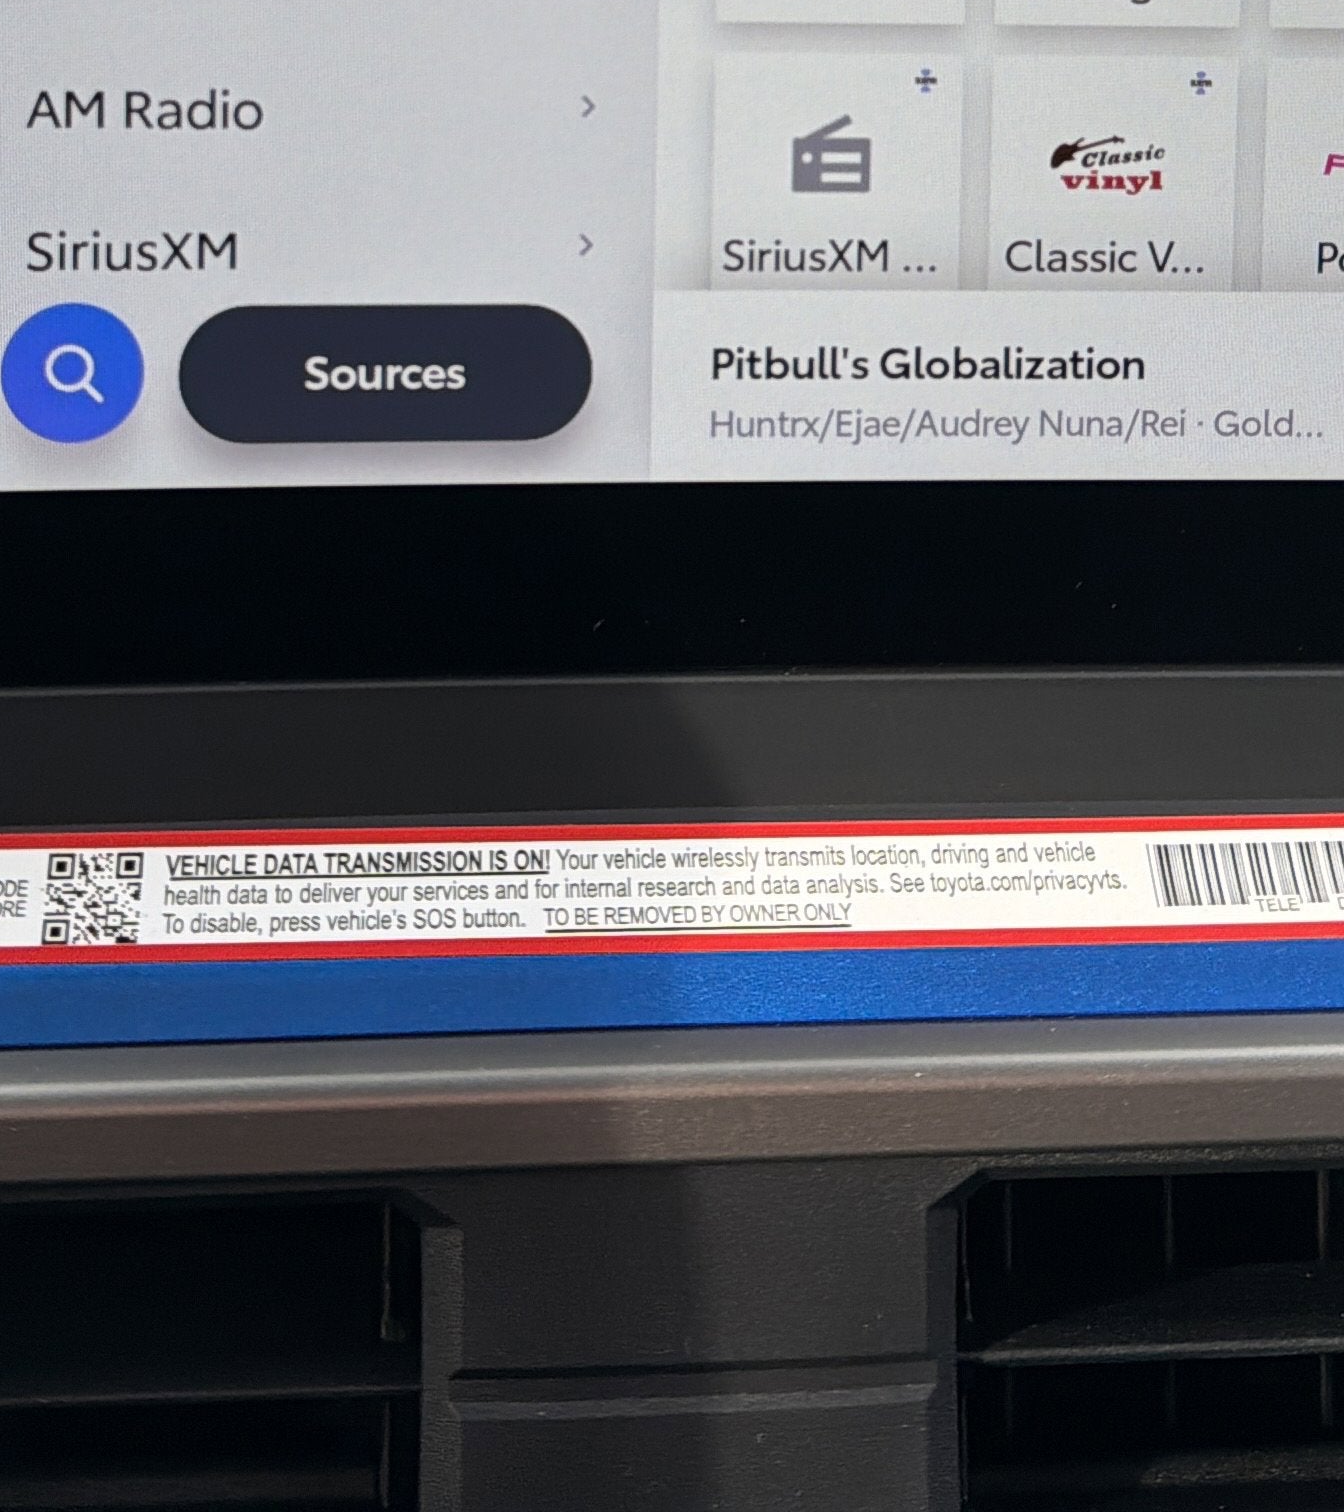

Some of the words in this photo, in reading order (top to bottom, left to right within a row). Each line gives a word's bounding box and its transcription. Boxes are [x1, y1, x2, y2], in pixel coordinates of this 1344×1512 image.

[25, 89, 106, 130] AM
[123, 89, 264, 130] Radio
[1081, 144, 1166, 168] Classic
[1060, 170, 1163, 196] vinyl
[25, 228, 240, 273] SiriusXM
[722, 239, 891, 276] SiriusXM
[1006, 238, 1137, 273] Classic
[304, 354, 467, 392] Sources
[712, 346, 870, 382] Pitbull's
[879, 346, 1146, 383] Globalization
[710, 408, 1030, 446] Huntrx/Ejae/Audrey
[1039, 409, 1187, 443] Nuna/Rei
[165, 854, 258, 876] VEHICLE
[264, 853, 319, 875] DATA
[323, 849, 483, 874] TRANSMISSION
[490, 850, 509, 871] IS
[514, 849, 550, 870] ON!
[556, 848, 598, 870] Your
[603, 848, 666, 869] vehicle
[671, 846, 759, 872] wirelessly
[764, 845, 846, 867] transmits
[851, 844, 926, 868] location,
[931, 843, 990, 868] driving
[996, 842, 1029, 864] and
[1034, 841, 1096, 863] vehicle
[163, 884, 221, 906] health
[227, 884, 268, 905] data
[275, 885, 293, 904] to
[299, 882, 361, 904] deliver
[367, 885, 408, 908] your
[413, 879, 489, 901] services
[495, 878, 529, 900] and
[535, 878, 560, 899] for
[564, 877, 632, 899] internal
[637, 875, 715, 898] research
[722, 873, 755, 895] and
[761, 874, 800, 895] data
[806, 873, 884, 899] analysis.
[889, 872, 925, 893] See
[930, 868, 1128, 898] toyota.com/privacyvts.
[1255, 895, 1301, 913] TELE
[162, 912, 184, 934] To
[190, 911, 263, 936] disable,
[269, 914, 321, 937] press
[326, 909, 406, 931] vehicle's
[413, 907, 457, 929] SOS
[463, 907, 526, 928] button.
[543, 907, 569, 926] TO
[574, 906, 600, 926] BE
[605, 905, 697, 925] REMOVED
[701, 904, 726, 923] BY
[729, 903, 800, 922] OWNER
[804, 902, 852, 921] ONLY
